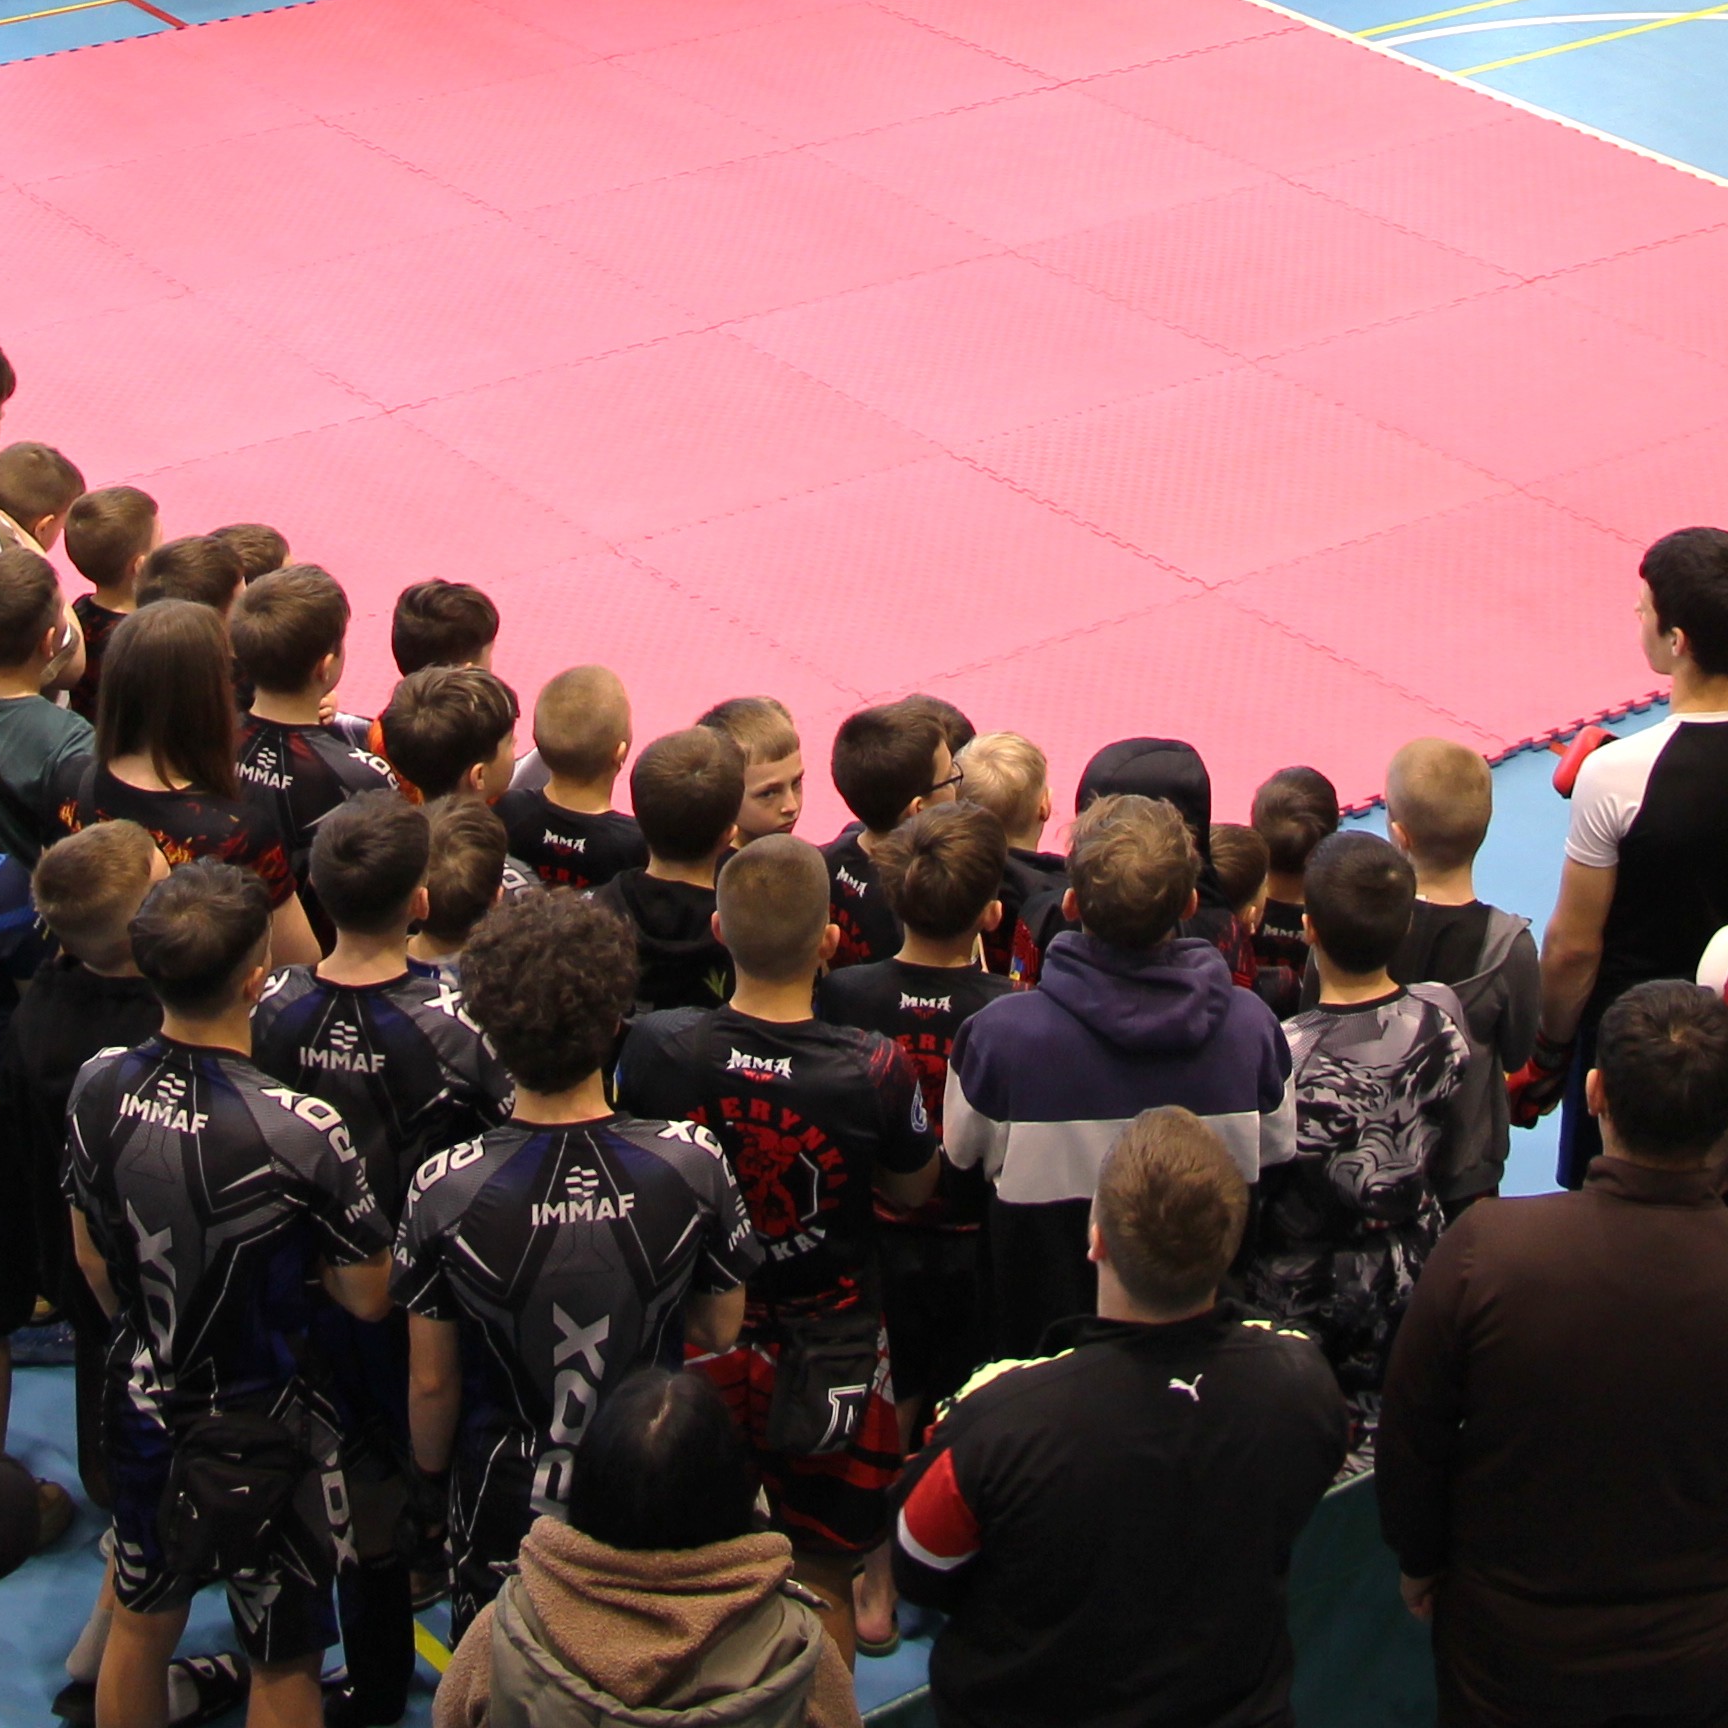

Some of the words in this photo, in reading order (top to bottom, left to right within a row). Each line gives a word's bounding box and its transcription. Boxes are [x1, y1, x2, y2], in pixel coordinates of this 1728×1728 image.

[234, 760, 294, 790] IMMAF
[542, 828, 587, 853] MMA
[835, 864, 869, 898] MMA
[898, 990, 953, 1013] MMA
[298, 1045, 386, 1074] IMMAF
[725, 1046, 791, 1080] MMA
[119, 1091, 210, 1135] IMMAF
[530, 1192, 635, 1227] IMMAF
[319, 1450, 359, 1575] DX
